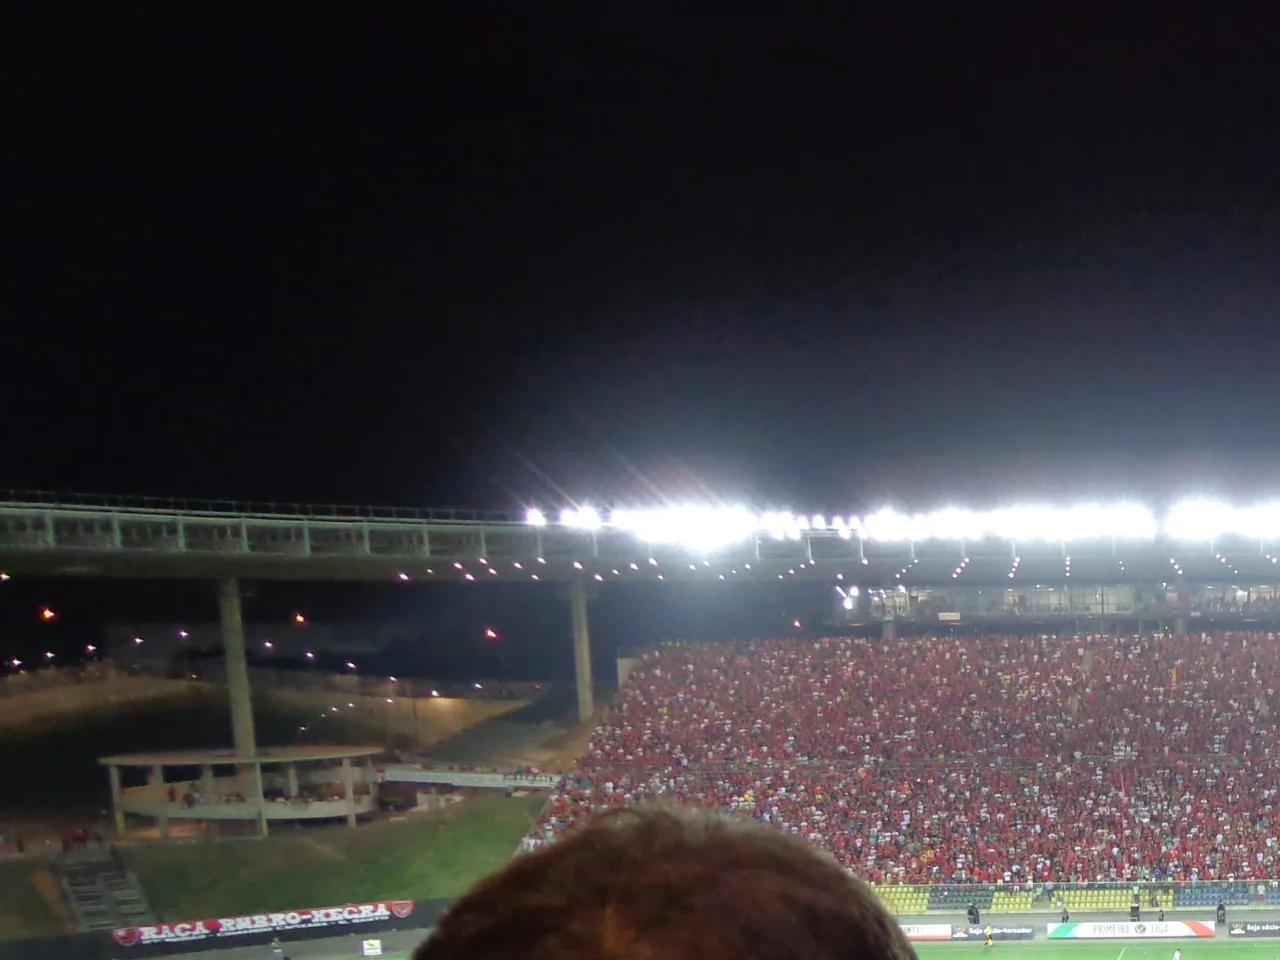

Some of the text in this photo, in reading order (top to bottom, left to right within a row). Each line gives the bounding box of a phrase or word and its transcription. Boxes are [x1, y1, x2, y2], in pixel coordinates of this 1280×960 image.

[1093, 924, 1169, 935] PRIMEIRA LIGA
[1246, 923, 1261, 932] Seja
